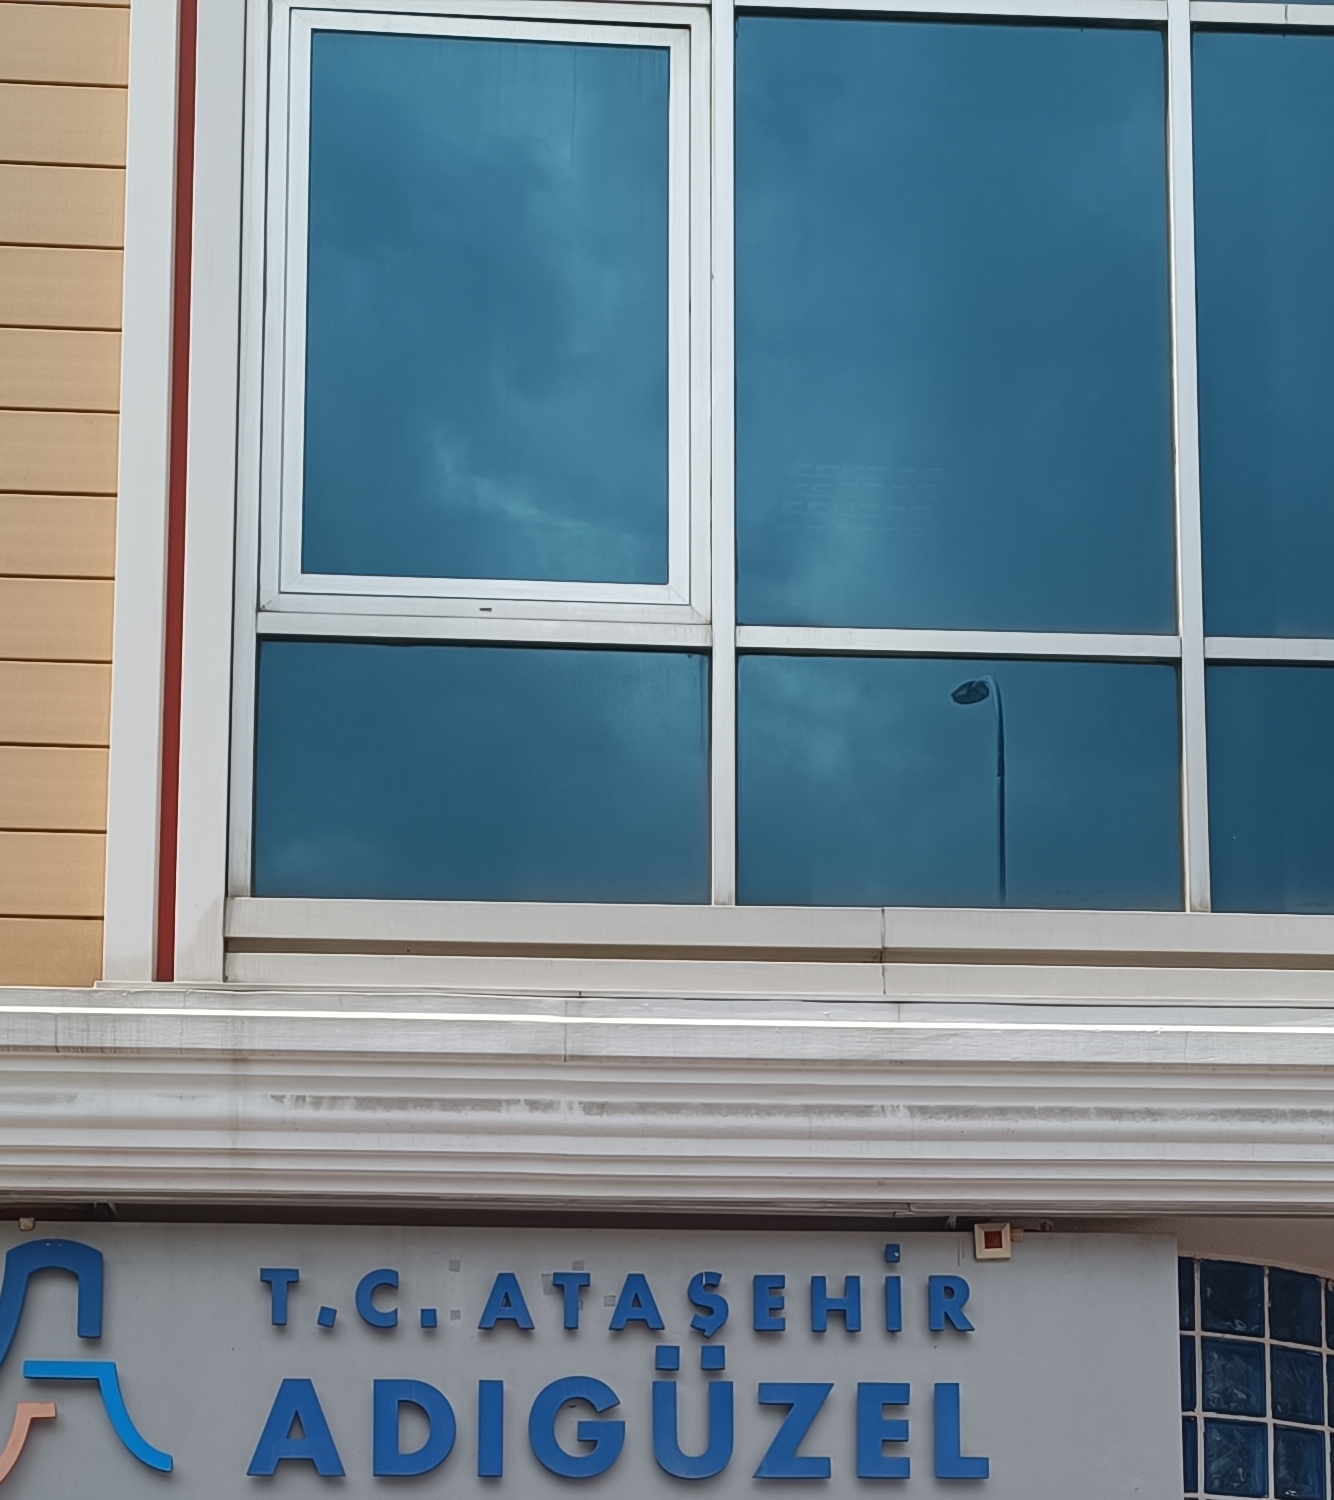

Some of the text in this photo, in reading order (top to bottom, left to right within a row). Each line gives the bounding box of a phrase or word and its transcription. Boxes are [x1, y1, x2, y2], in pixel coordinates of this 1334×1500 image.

[260, 1242, 975, 1338] T.C. ATAŞEHİR
[247, 1345, 990, 1480] ADIGÜZEL
